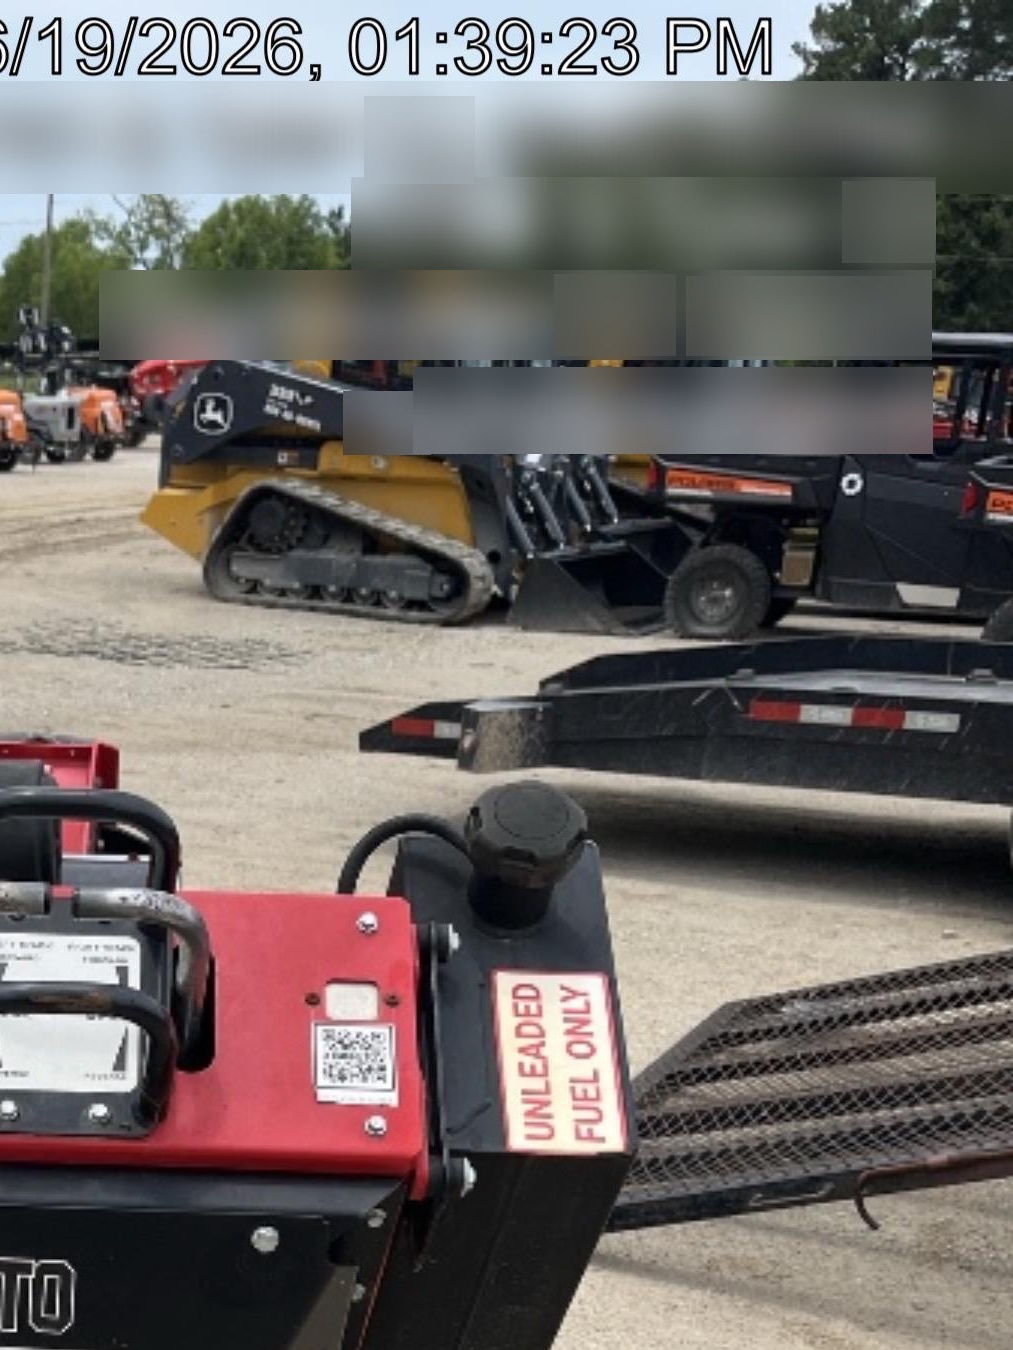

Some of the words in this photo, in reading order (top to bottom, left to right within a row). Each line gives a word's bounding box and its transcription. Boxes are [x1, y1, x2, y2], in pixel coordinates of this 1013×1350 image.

[559, 984, 597, 1060] ONLY
[511, 983, 555, 1141] UNLEADED
[569, 1069, 606, 1143] FUEL
